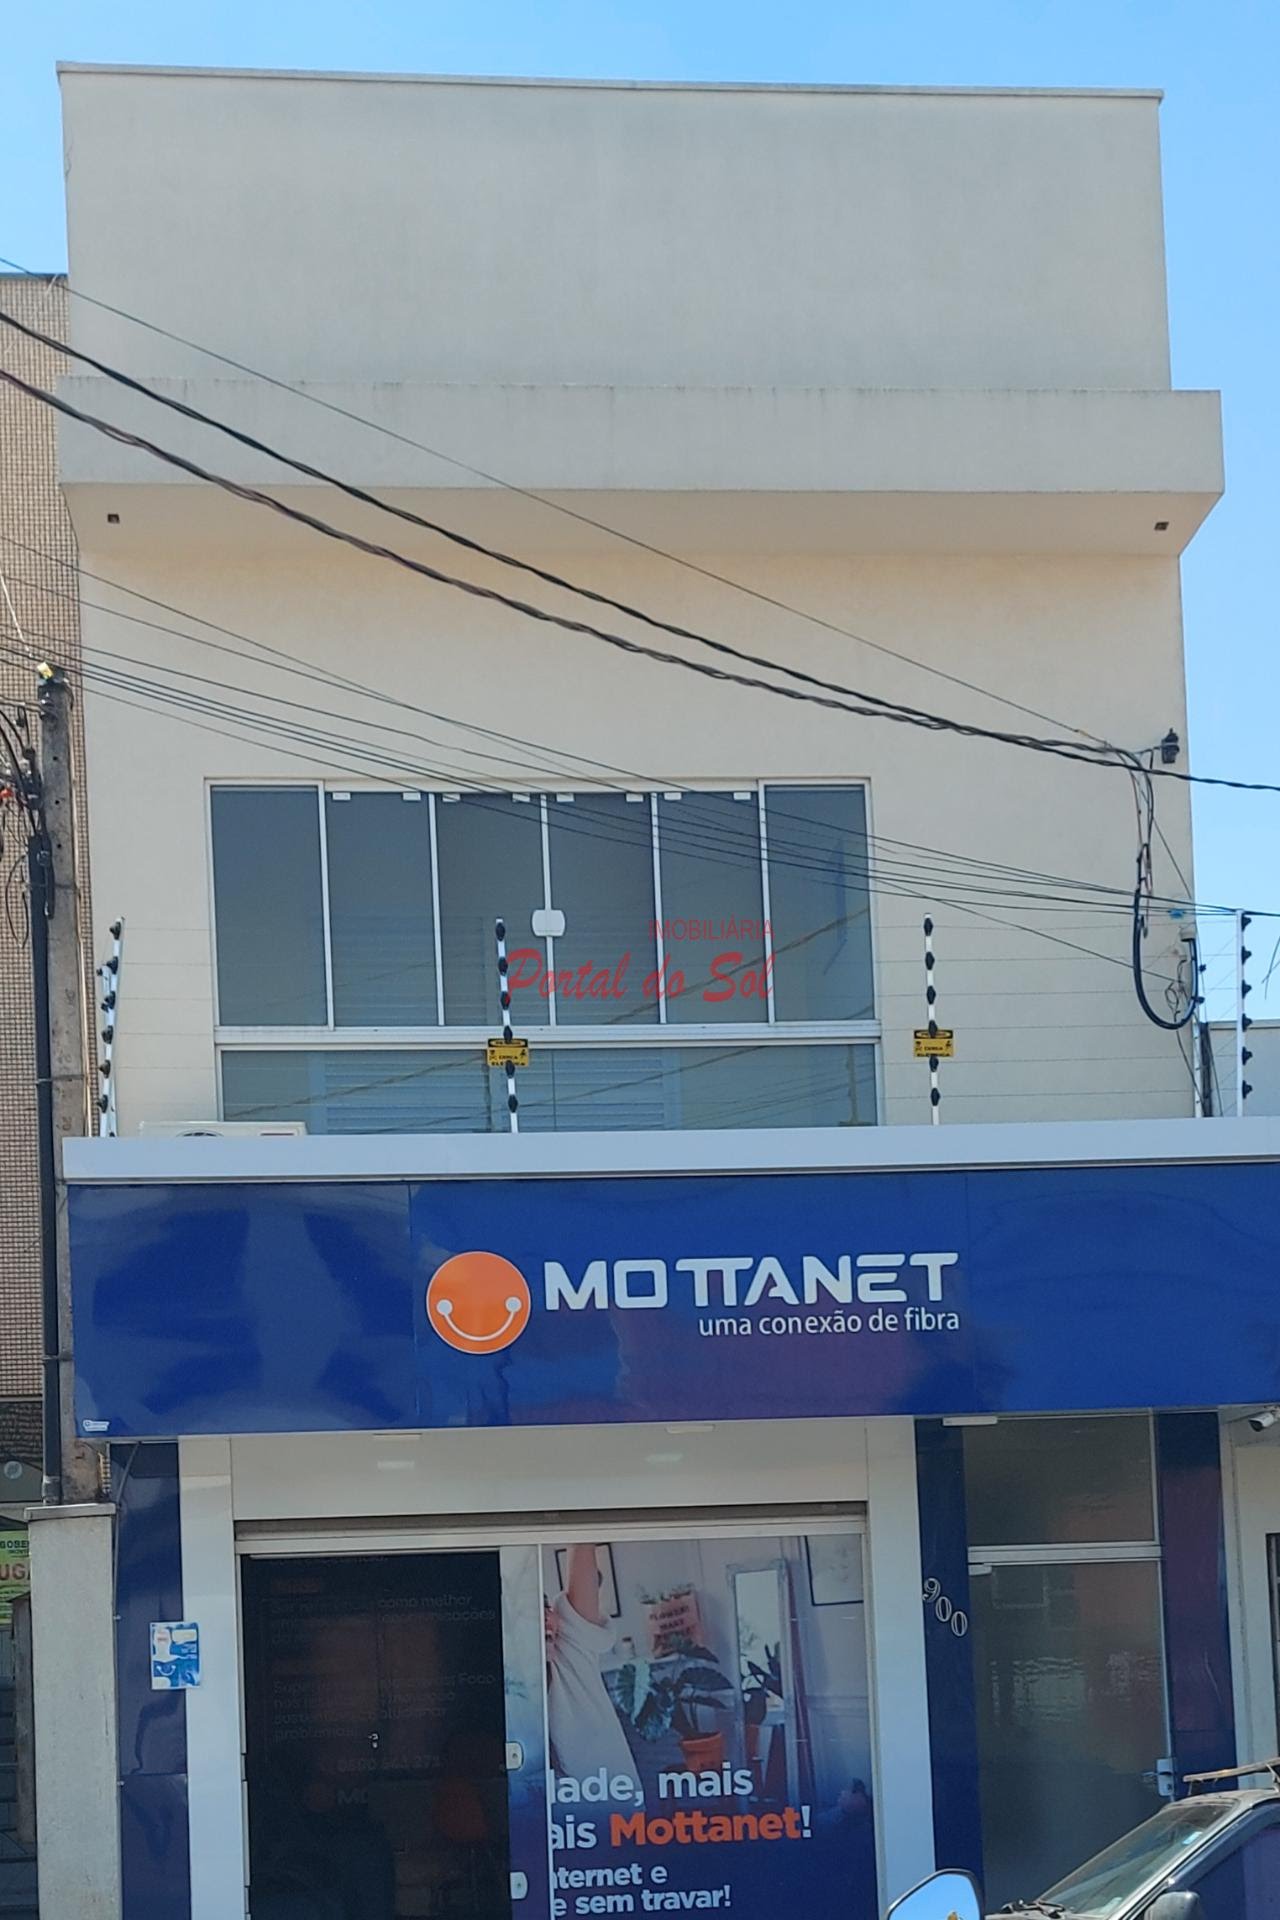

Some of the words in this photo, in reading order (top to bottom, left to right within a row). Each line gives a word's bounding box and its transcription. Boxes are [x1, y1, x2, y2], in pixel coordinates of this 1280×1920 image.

[544, 1252, 958, 1310] MOTTANET
[699, 1316, 752, 1337] uma
[760, 1309, 862, 1335] conexão
[868, 1308, 898, 1333] de
[904, 1307, 960, 1331] fibra
[0, 1563, 31, 1580] UG
[922, 1577, 968, 1637] 900
[658, 1762, 753, 1798] mais
[610, 1805, 811, 1847] Mottanet!
[650, 1865, 668, 1884] e
[575, 1894, 634, 1915] sem
[641, 1885, 731, 1911] travar!
